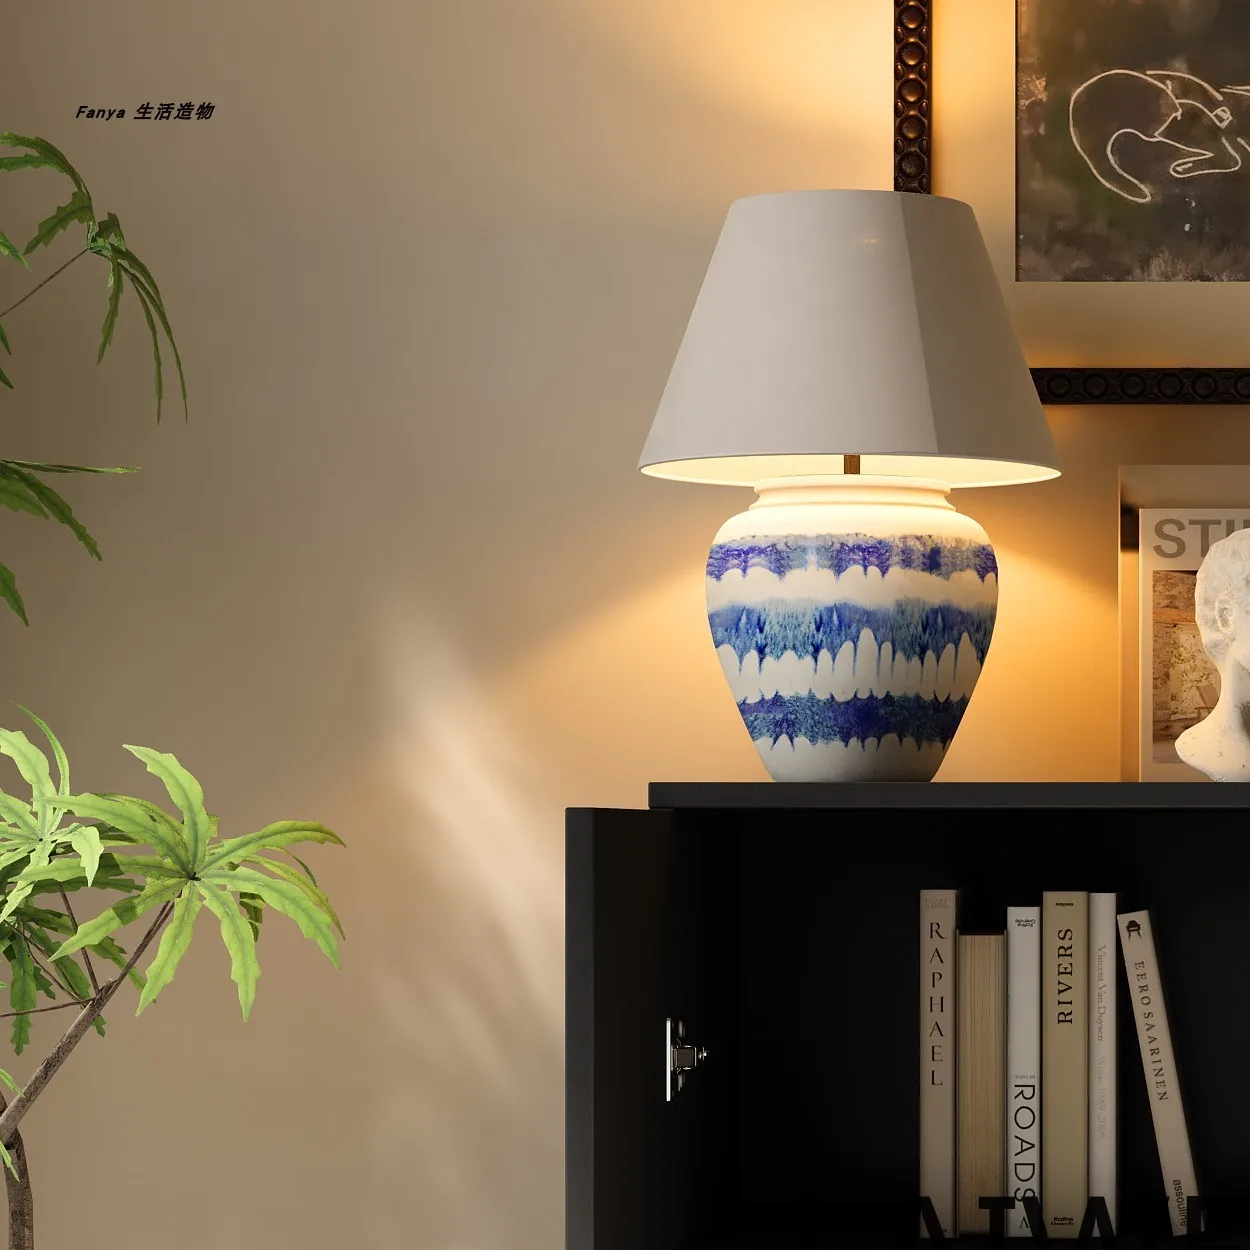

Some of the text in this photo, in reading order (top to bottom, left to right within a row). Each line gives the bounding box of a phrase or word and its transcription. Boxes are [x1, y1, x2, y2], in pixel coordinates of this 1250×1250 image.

[929, 922, 948, 1086] RAPHAEL
[1057, 928, 1074, 1025] RIVERS
[1097, 945, 1107, 982] Vincent
[1097, 984, 1107, 1003] Van
[1095, 1005, 1107, 1042] Duysen
[1134, 961, 1169, 1101] EERO SAARINEN
[1013, 1084, 1036, 1203] ROADS
